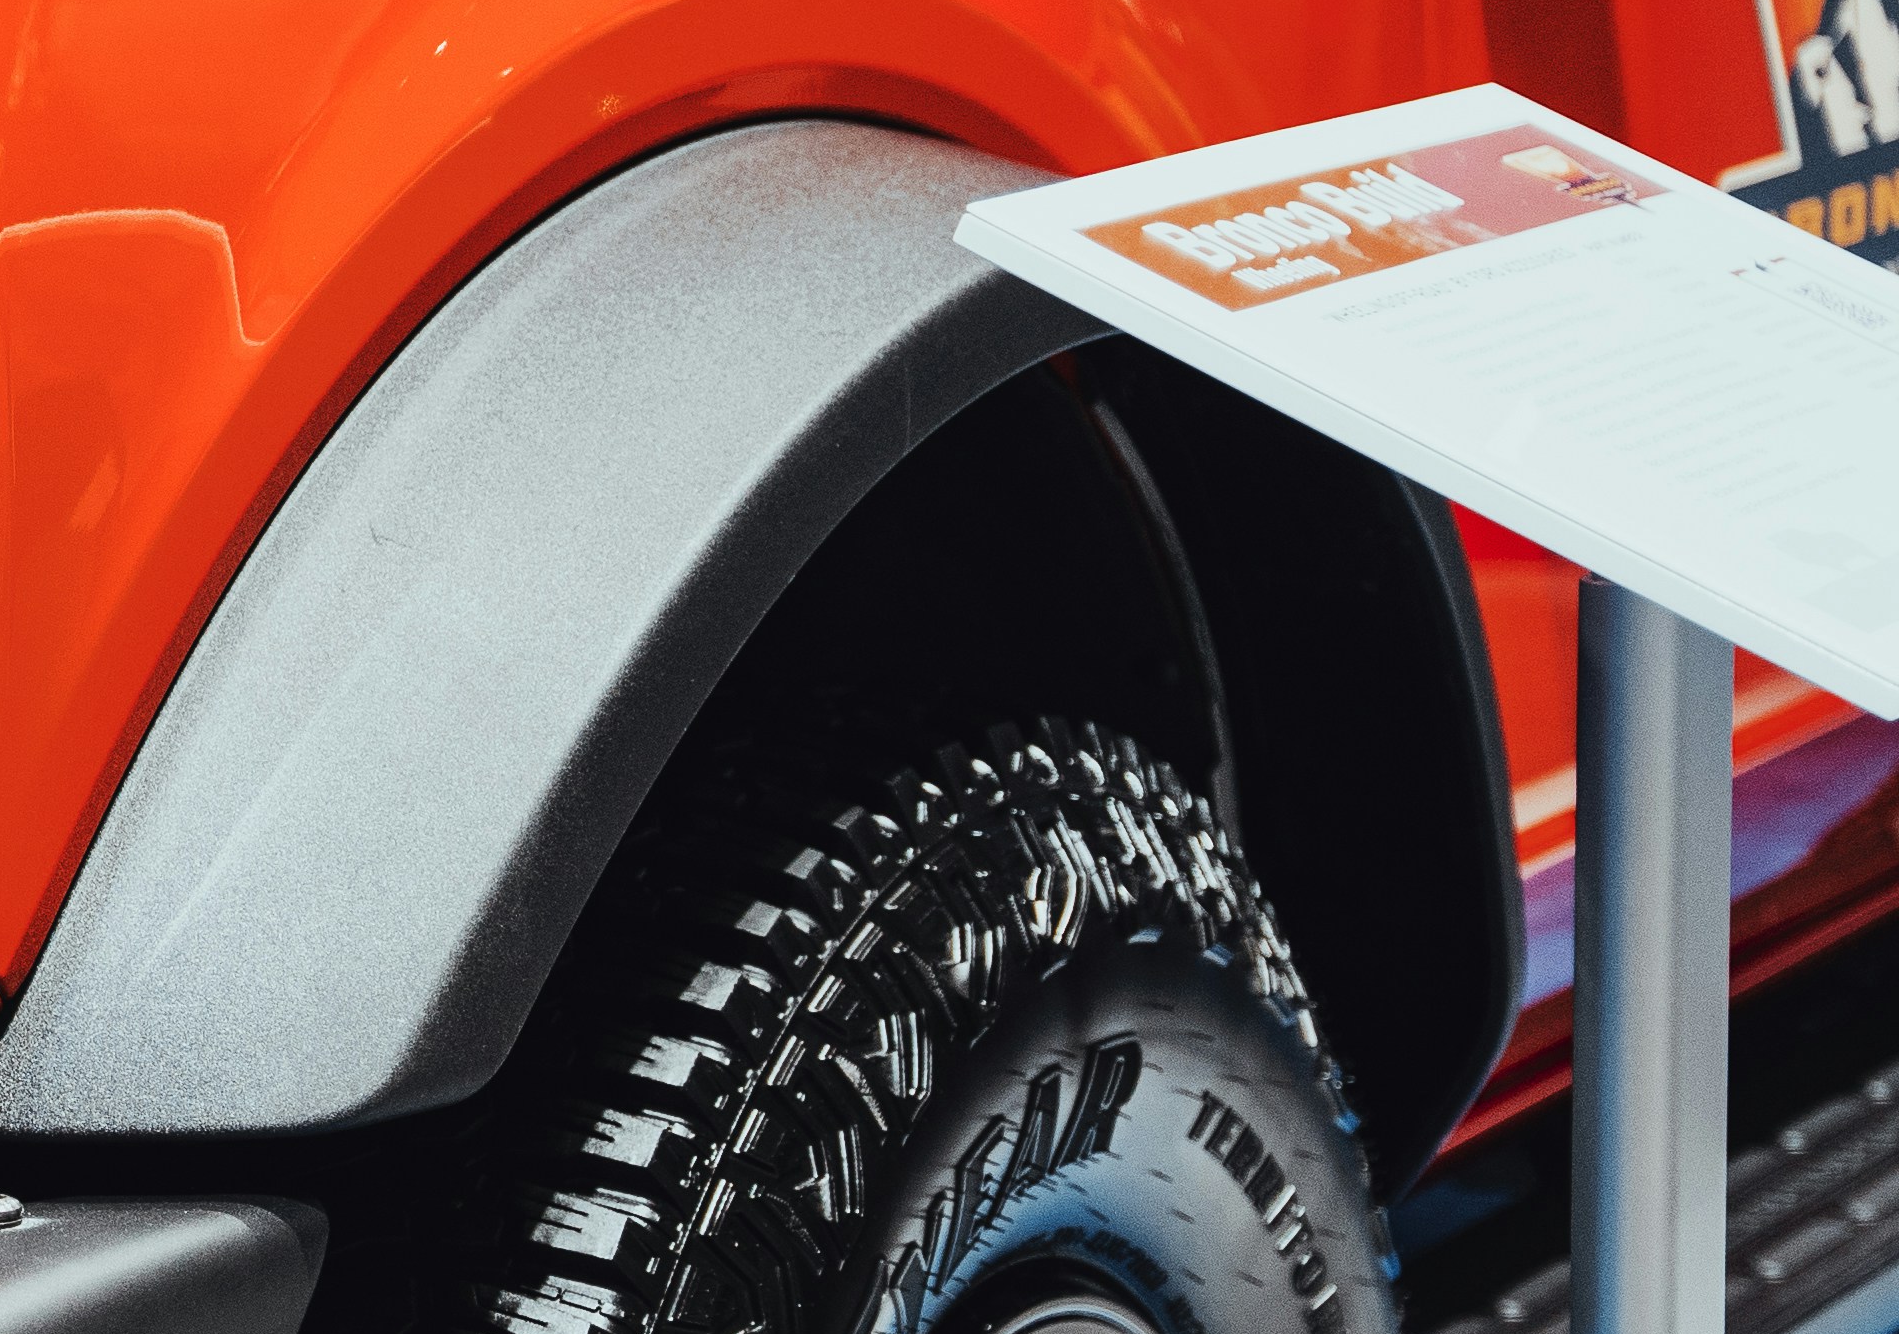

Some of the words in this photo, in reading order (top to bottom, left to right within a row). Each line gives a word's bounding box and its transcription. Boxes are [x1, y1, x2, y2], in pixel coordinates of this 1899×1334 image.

[1141, 201, 1351, 271] Bronco
[1299, 162, 1465, 229] Build
[1768, 167, 1899, 247] RON
